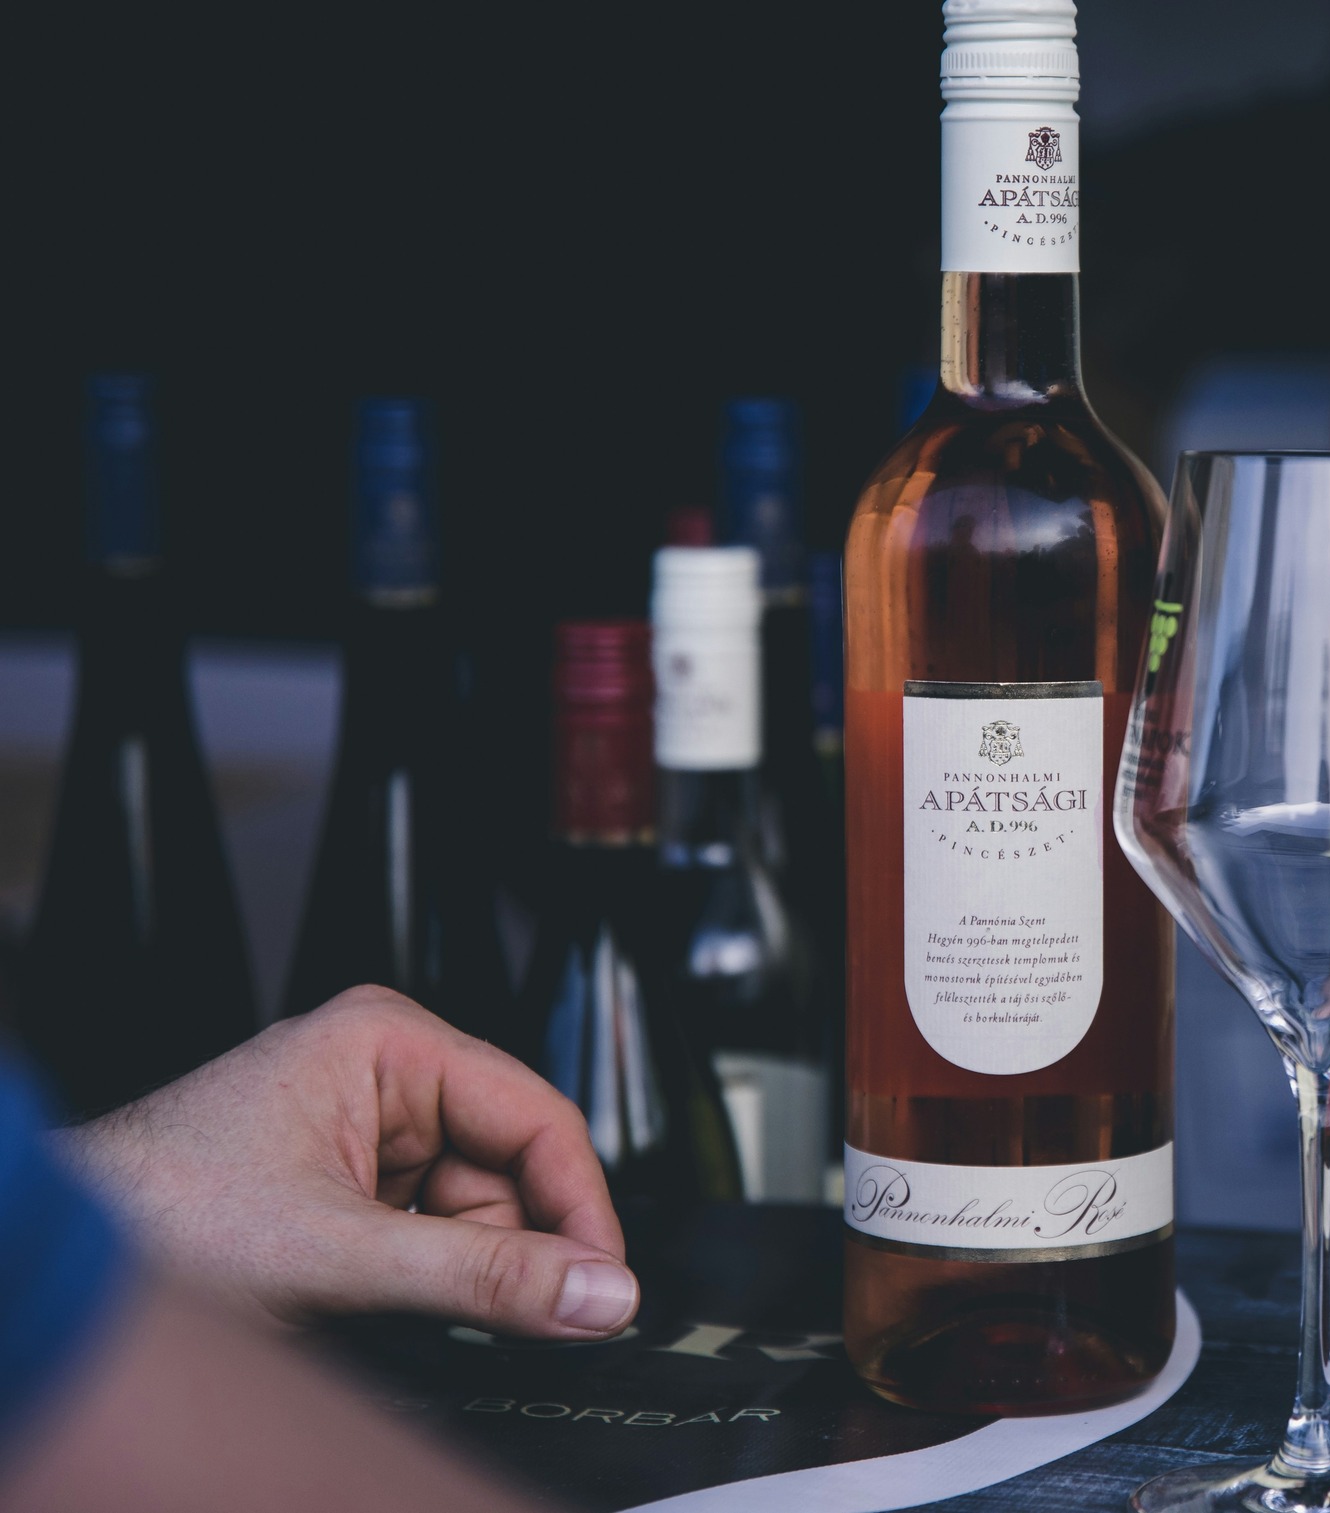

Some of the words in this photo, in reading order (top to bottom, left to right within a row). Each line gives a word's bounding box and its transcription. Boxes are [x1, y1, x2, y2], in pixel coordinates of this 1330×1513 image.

[995, 174, 1076, 184] PANNONHALMI
[943, 772, 1060, 783] PANNONHALMI
[918, 785, 1087, 812] APÁTSÁGI
[958, 915, 966, 926] A
[970, 915, 1016, 926] Pannónia
[1018, 915, 1046, 929] Szent
[927, 933, 963, 948] Hegyén
[966, 934, 1008, 948] 996-ban
[1011, 932, 1079, 948] megtelepedett
[926, 951, 955, 964] bencés
[958, 953, 1010, 967] szerzetesek
[1013, 952, 1068, 968] templomuk
[1071, 953, 1080, 963] és
[924, 972, 981, 984] monostoruk
[984, 973, 1033, 988] építésével
[1034, 971, 1083, 987] egyidőben
[933, 991, 997, 1006] felélesztették
[1008, 994, 1022, 1007] táj
[1024, 993, 1039, 1004] ősi
[1041, 991, 1072, 1006] szőlő-
[963, 1012, 973, 1023] és
[852, 1165, 1036, 1228] Pannonhalmi
[1033, 1168, 1127, 1239] Rosé
